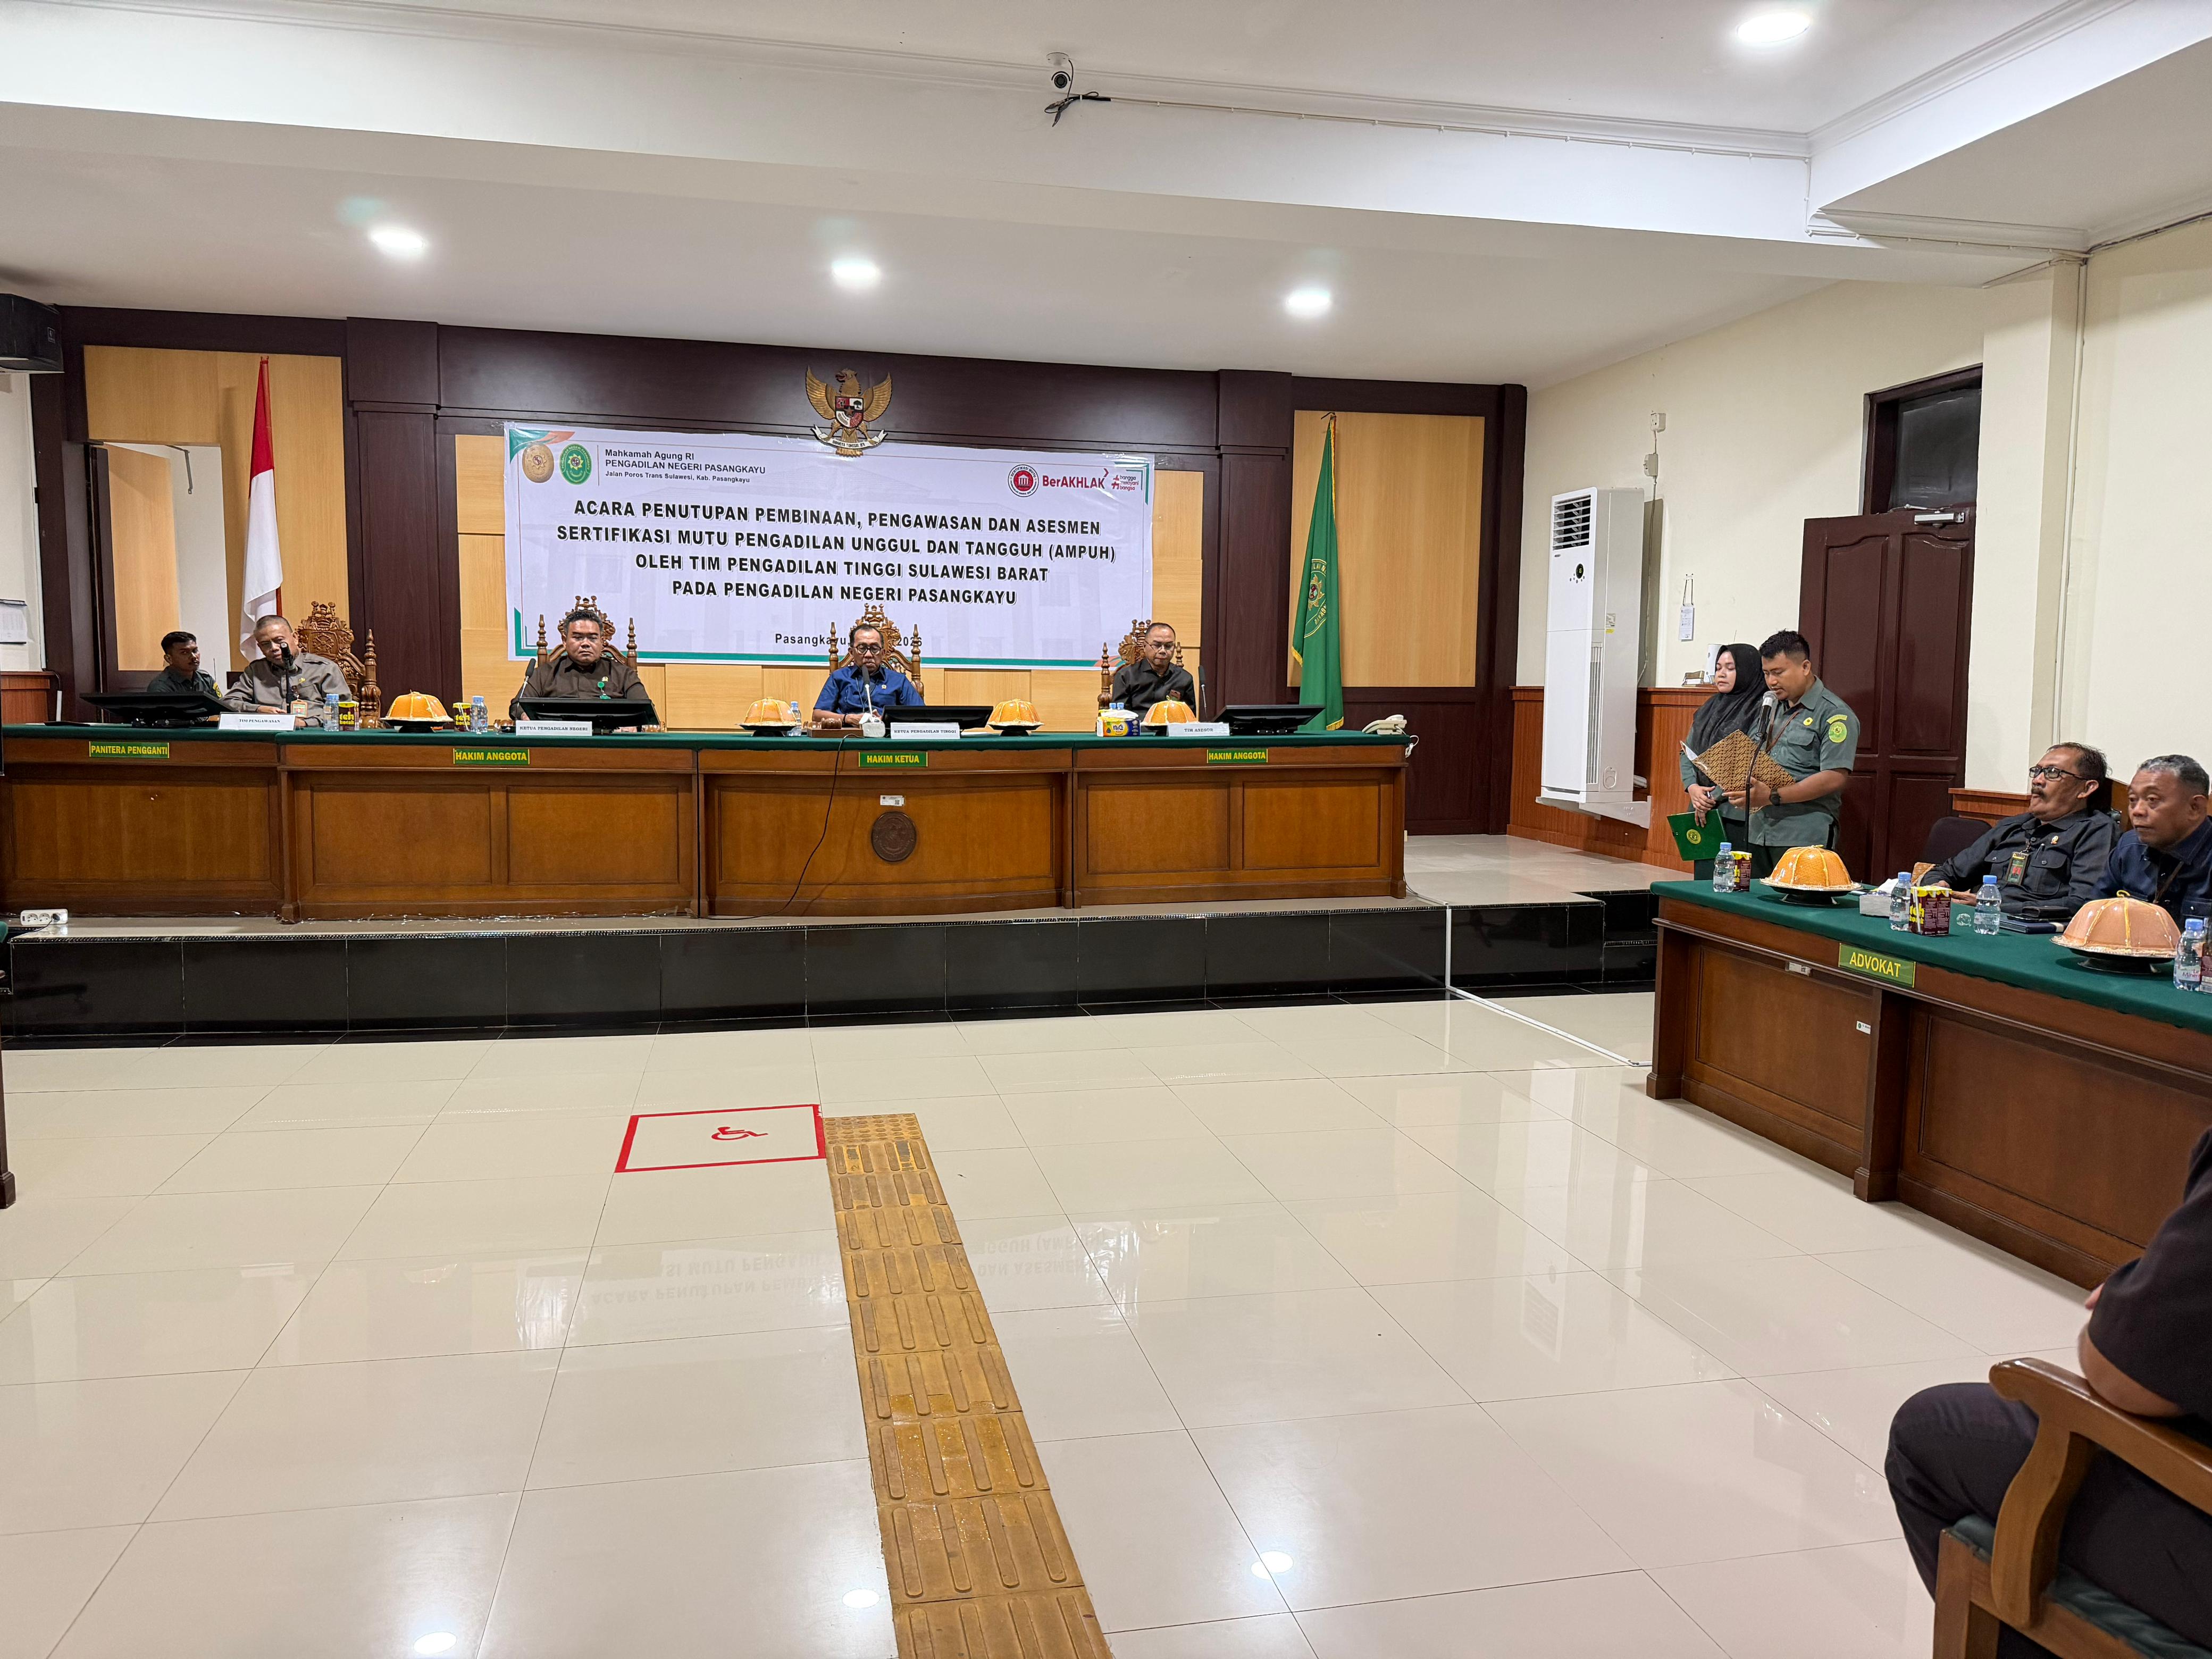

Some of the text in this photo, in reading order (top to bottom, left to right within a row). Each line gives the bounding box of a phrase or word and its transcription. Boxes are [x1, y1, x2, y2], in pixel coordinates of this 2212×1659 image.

[605, 449, 652, 458] Mahkamah
[654, 451, 682, 461] Agung
[606, 459, 765, 474] PENGADILAN NEGERI PASANGKAYU
[1042, 475, 1105, 489] BerAKHLAK
[574, 500, 1100, 534] ACARA PENUTUPAN PEMBINAAN, PENGAWASAN DAN ASESMEN
[557, 525, 1115, 563] SERTIFIKASI MUTU PENGADILAN UNGGUL DAN TANGGUH (AMPUH)
[636, 554, 1048, 581] OLEH TIM PENGADILAN TINGGI SULAWESI BARAT
[673, 581, 1016, 605] PADA PENGADILAN NEGERI PASANGKAYU
[91, 745, 167, 755] PANITERA PENGGANTI
[455, 751, 527, 761] HAKIM ANGGOTA
[895, 755, 919, 764] KETUA
[1849, 952, 1901, 977] ADVOKAT
